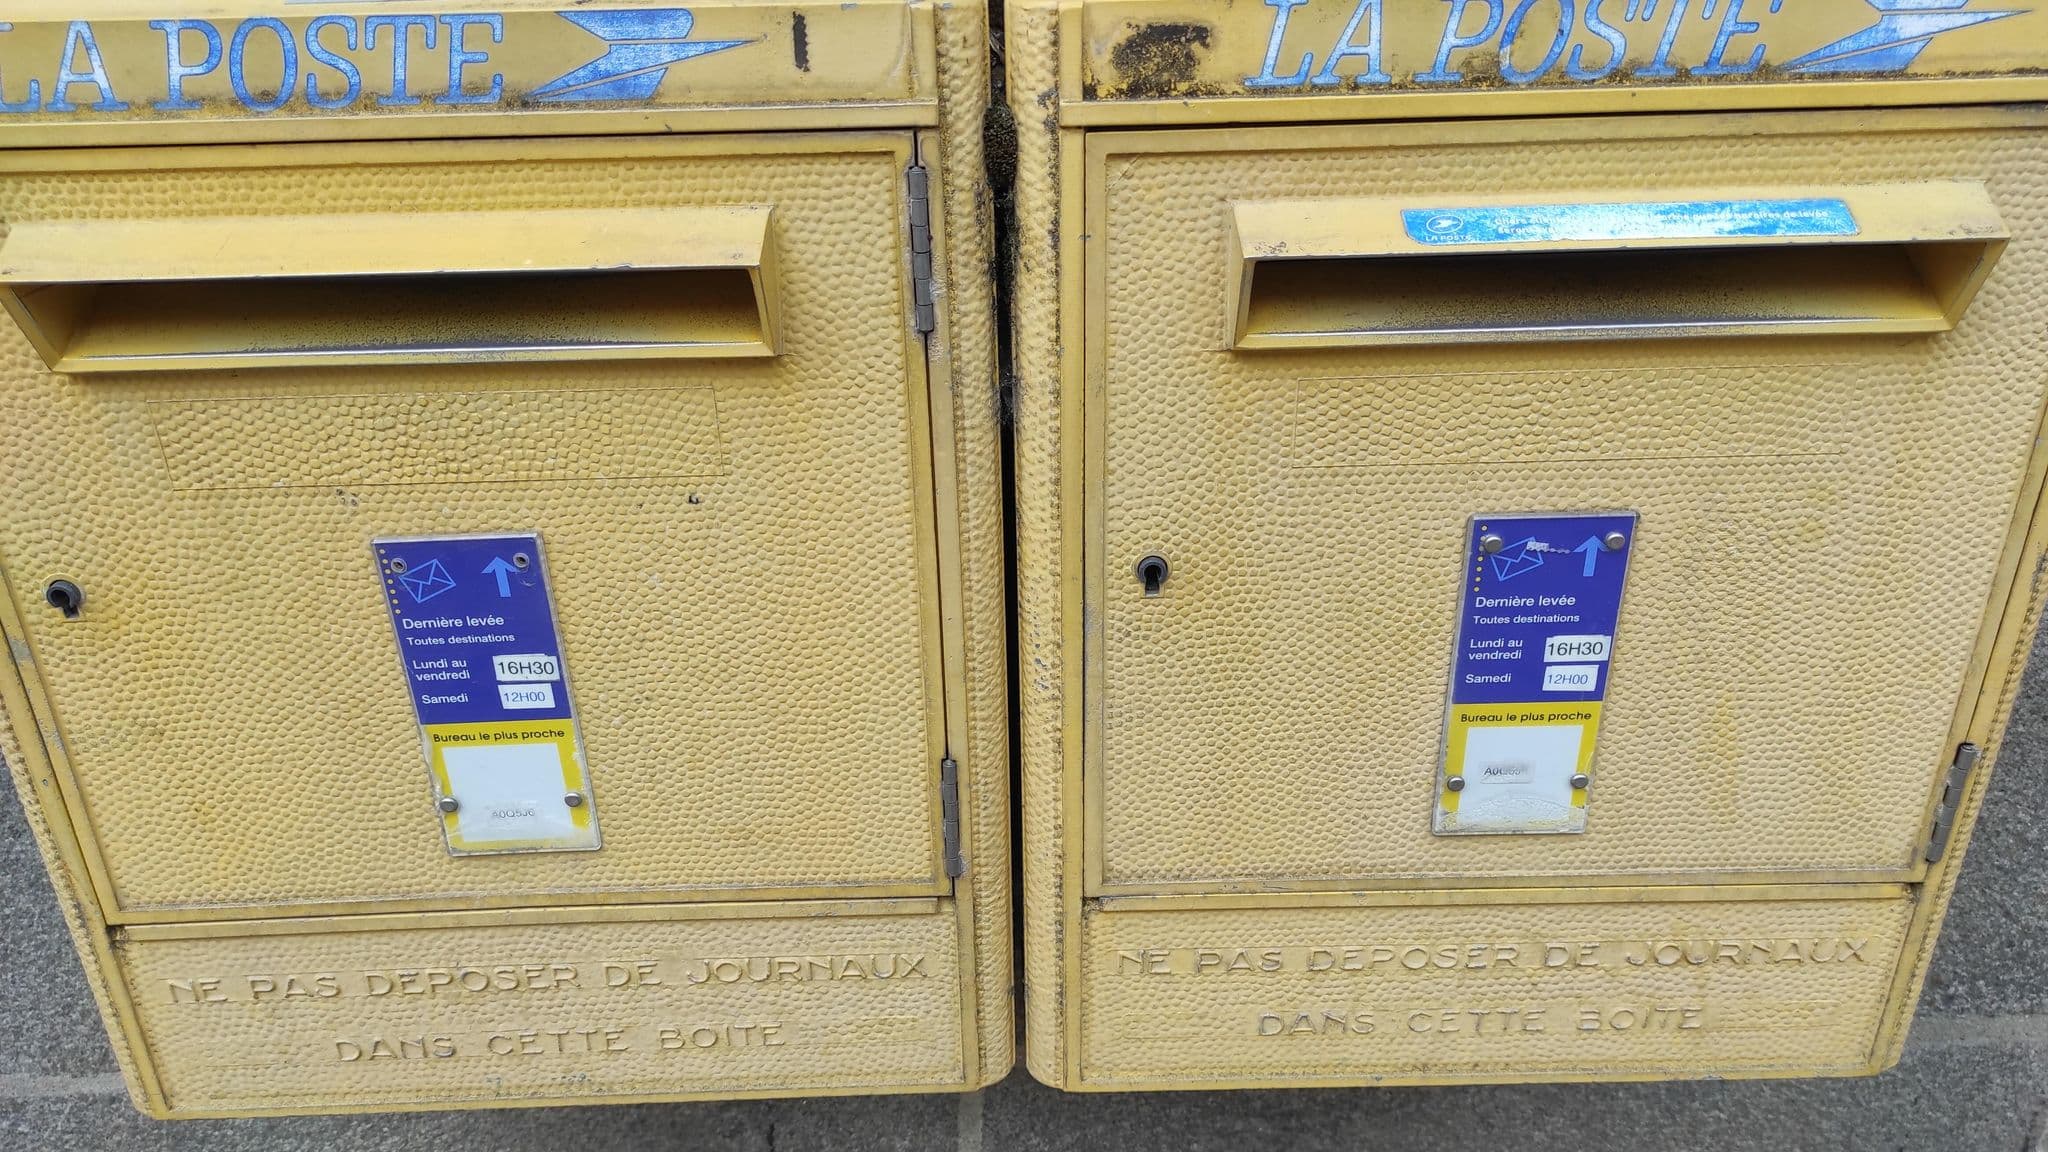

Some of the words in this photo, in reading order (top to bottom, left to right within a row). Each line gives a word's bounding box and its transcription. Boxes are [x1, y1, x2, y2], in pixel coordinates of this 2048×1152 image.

[1244, 0, 1392, 87] LA
[1413, 0, 1783, 85] POSTE
[149, 13, 503, 112] POSTE
[1475, 595, 1535, 608] Dernière
[1538, 594, 1576, 606] levée
[402, 615, 463, 630] Dernière
[466, 613, 505, 627] levée
[1473, 615, 1511, 625] Toutes
[1513, 613, 1580, 624] destinations
[405, 636, 446, 646] Toutes
[449, 632, 516, 645] destinations
[1470, 637, 1506, 648] Lundi
[1507, 638, 1523, 648] au
[1468, 649, 1522, 660] vendredi
[1548, 641, 1604, 656] 16H30
[412, 658, 449, 669] Lundi
[451, 659, 467, 668] au
[497, 661, 555, 676] 16H30
[415, 669, 471, 682] vendredi
[1465, 673, 1511, 684] Samedi
[1547, 673, 1589, 685] 12H00
[421, 692, 469, 705] Samedi
[503, 691, 546, 703] 12H00
[1460, 713, 1503, 723] Bureau
[1506, 712, 1517, 721] le
[1520, 712, 1545, 723] plus
[1547, 711, 1592, 723] proche
[433, 732, 476, 743] Bureau
[478, 732, 490, 741] le
[493, 731, 519, 743] plus
[521, 729, 565, 742] proche
[1117, 948, 1171, 975] NE
[1193, 947, 1282, 975] PAS
[1306, 942, 1522, 974] DEPOSER
[1543, 941, 1600, 968] DE
[1626, 937, 1868, 967] JOURNAUX
[166, 976, 228, 1003] NE
[246, 973, 341, 1000] PAS
[364, 963, 582, 998] DEPOSER
[603, 959, 662, 988] DE
[686, 953, 928, 984] JOURNAUX
[1258, 1011, 1375, 1038] DANS
[1406, 1007, 1547, 1036] CETTE
[1576, 1006, 1704, 1032] BOITE
[335, 1035, 457, 1062] DANS
[487, 1027, 629, 1057] CETTE
[657, 1020, 785, 1051] BOITE
